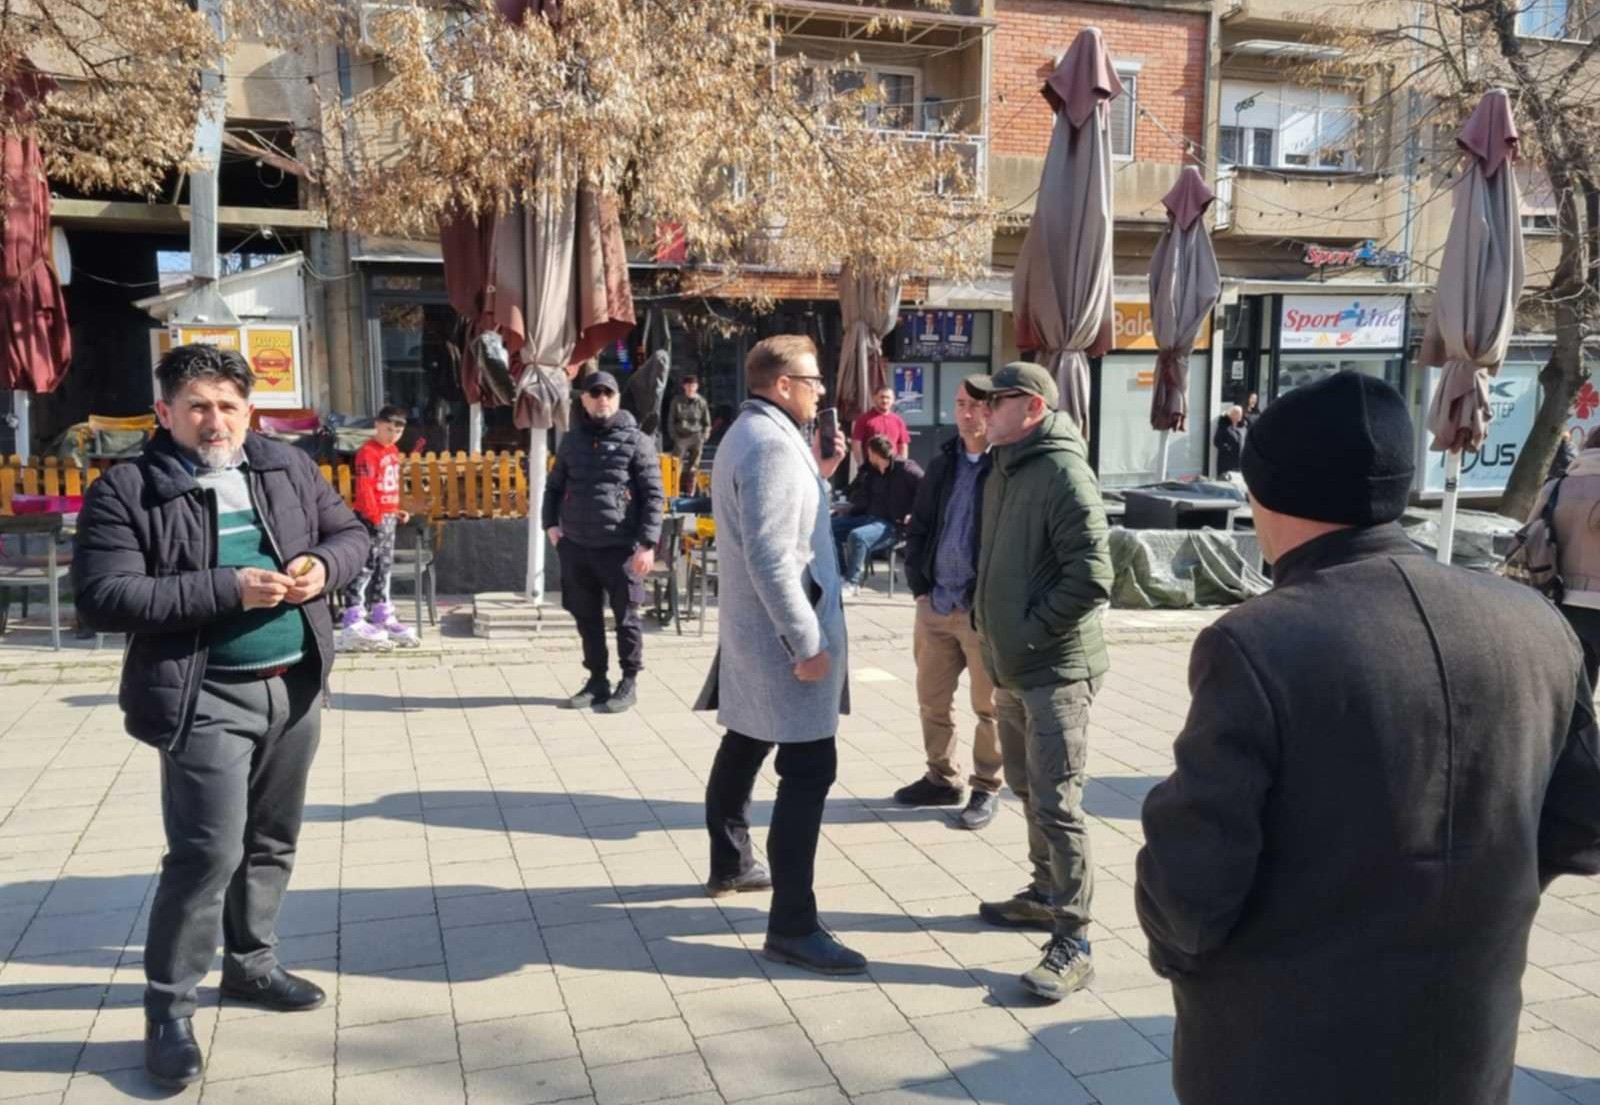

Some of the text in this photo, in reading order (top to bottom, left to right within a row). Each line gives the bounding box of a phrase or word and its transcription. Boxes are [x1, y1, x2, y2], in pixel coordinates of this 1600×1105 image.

[1304, 246, 1357, 267] Sport
[1283, 308, 1401, 332] Sport Line
